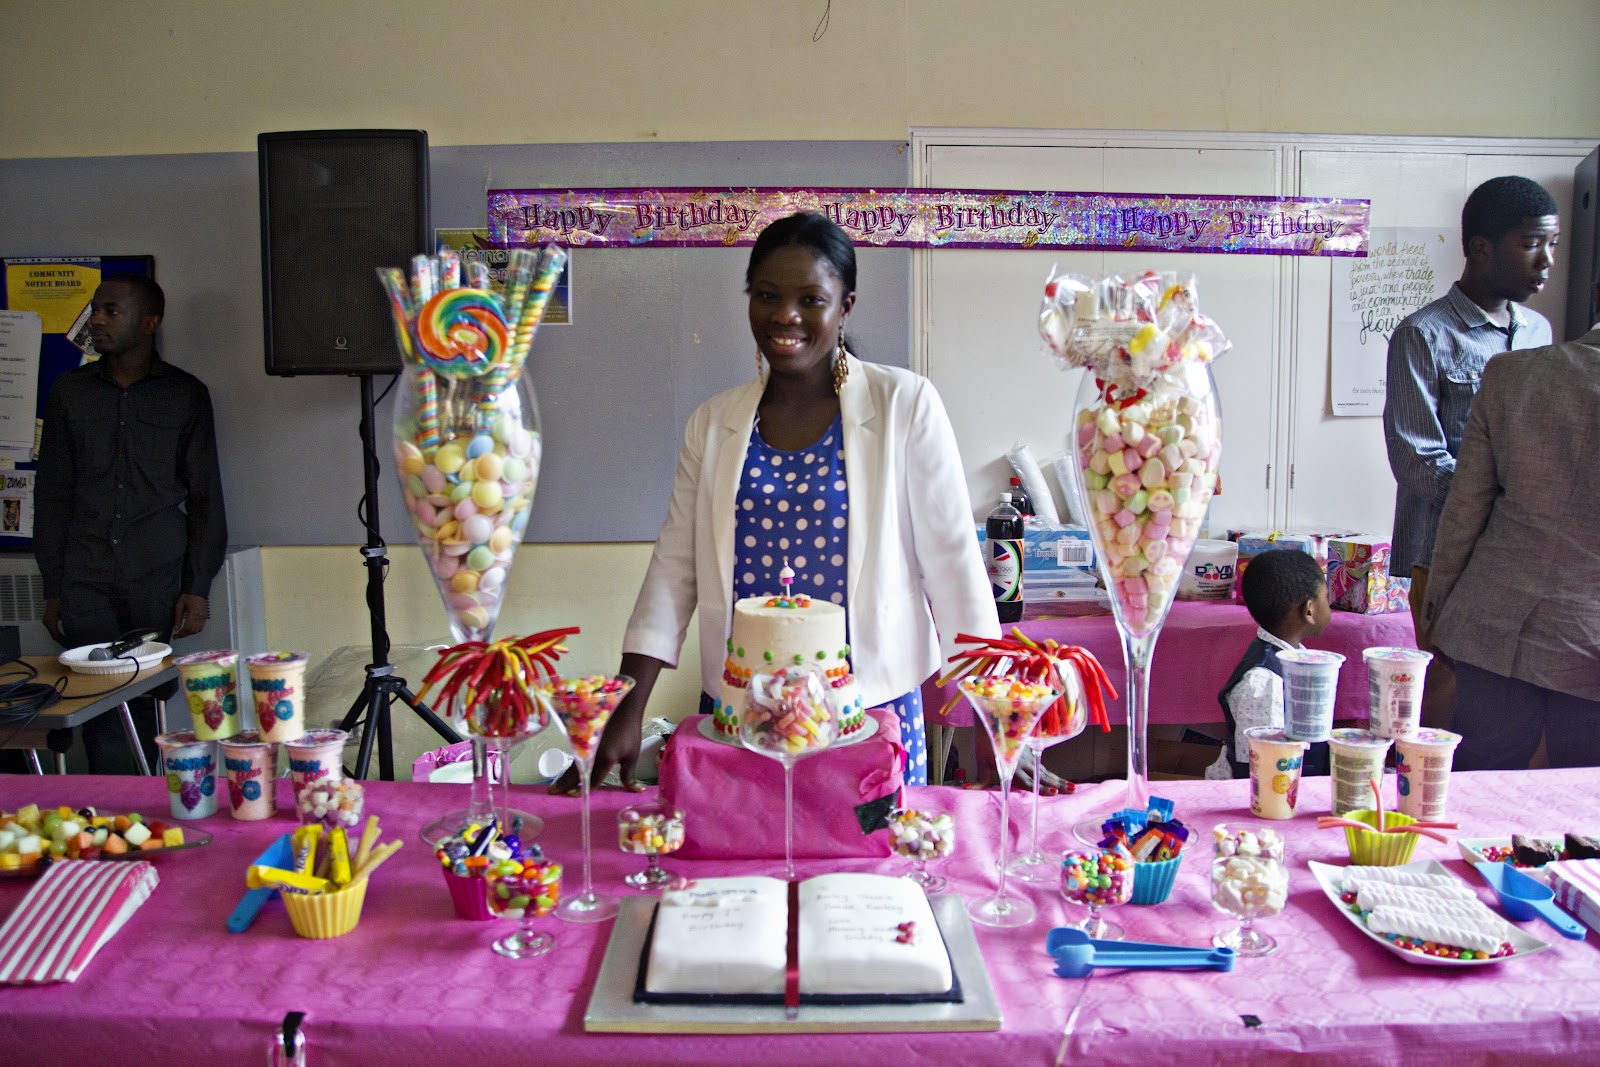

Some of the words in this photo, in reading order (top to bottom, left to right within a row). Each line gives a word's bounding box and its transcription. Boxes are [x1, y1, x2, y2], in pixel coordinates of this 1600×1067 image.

[521, 202, 615, 235] Happy
[632, 199, 762, 231] Birthday
[821, 201, 915, 236] Happy
[933, 201, 1060, 234] Birthday
[1117, 206, 1210, 242] Happy
[1224, 209, 1345, 241] Birthday
[1369, 241, 1397, 258] world
[1399, 241, 1426, 257] freed
[1372, 258, 1386, 269] the
[1387, 256, 1419, 267] scandal
[1420, 254, 1430, 270] of
[29, 270, 75, 278] COMMUNITY
[1383, 268, 1404, 280] where
[1405, 266, 1434, 281] trade
[1349, 288, 1358, 300] is
[1358, 285, 1377, 302] just
[1382, 280, 1400, 294] and
[1401, 280, 1435, 298] people
[1351, 301, 1367, 312] and
[1375, 306, 1392, 317] can
[186, 674, 231, 692] CANDY
[166, 756, 211, 772] CANDY
[1276, 757, 1302, 772] CAN
